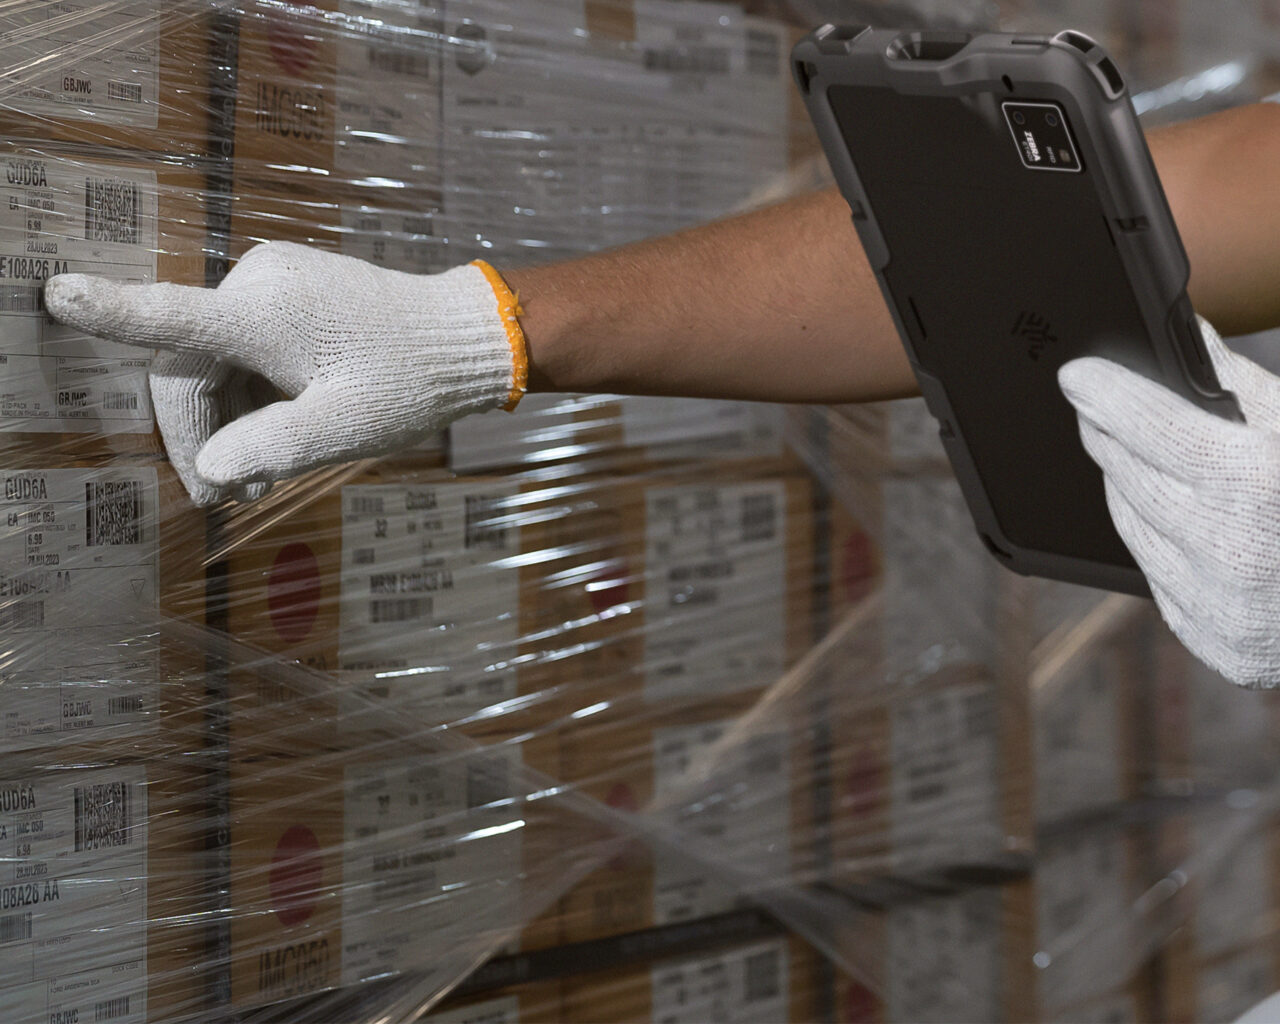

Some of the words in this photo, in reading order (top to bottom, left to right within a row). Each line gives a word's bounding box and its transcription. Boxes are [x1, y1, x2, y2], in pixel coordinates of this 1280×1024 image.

[63, 77, 92, 94] GBJWC
[1023, 130, 1041, 162] ZEBRA
[6, 162, 48, 187] GUD6A
[58, 391, 88, 407] GBJWC
[5, 477, 48, 500] GUD6A
